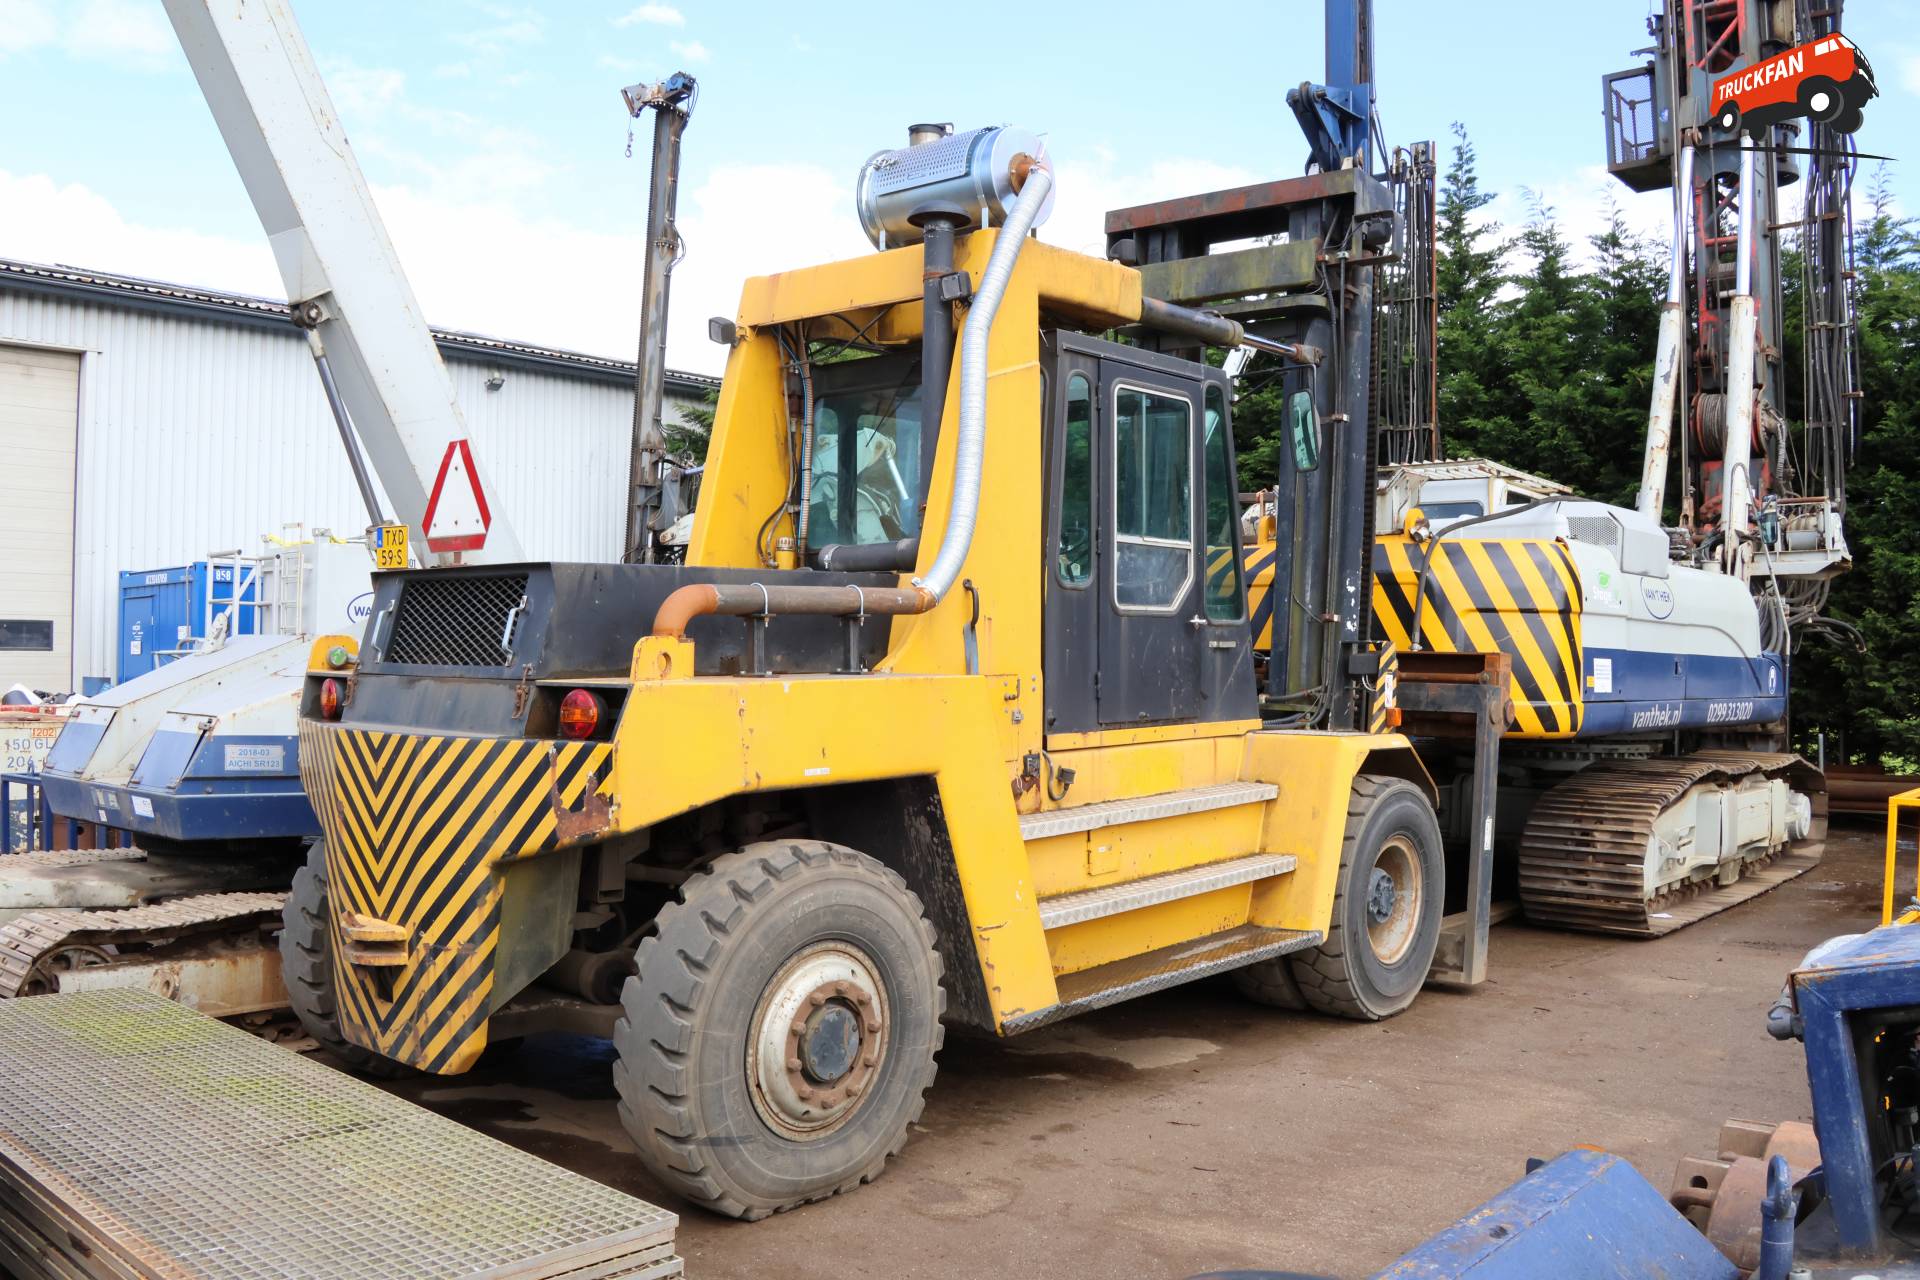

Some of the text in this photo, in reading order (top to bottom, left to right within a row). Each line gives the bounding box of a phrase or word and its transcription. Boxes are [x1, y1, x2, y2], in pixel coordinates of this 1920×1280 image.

[385, 529, 404, 546] TXD
[215, 570, 232, 581] 858
[1632, 703, 1683, 728] vanthek.nl
[238, 748, 270, 756] 2018-03
